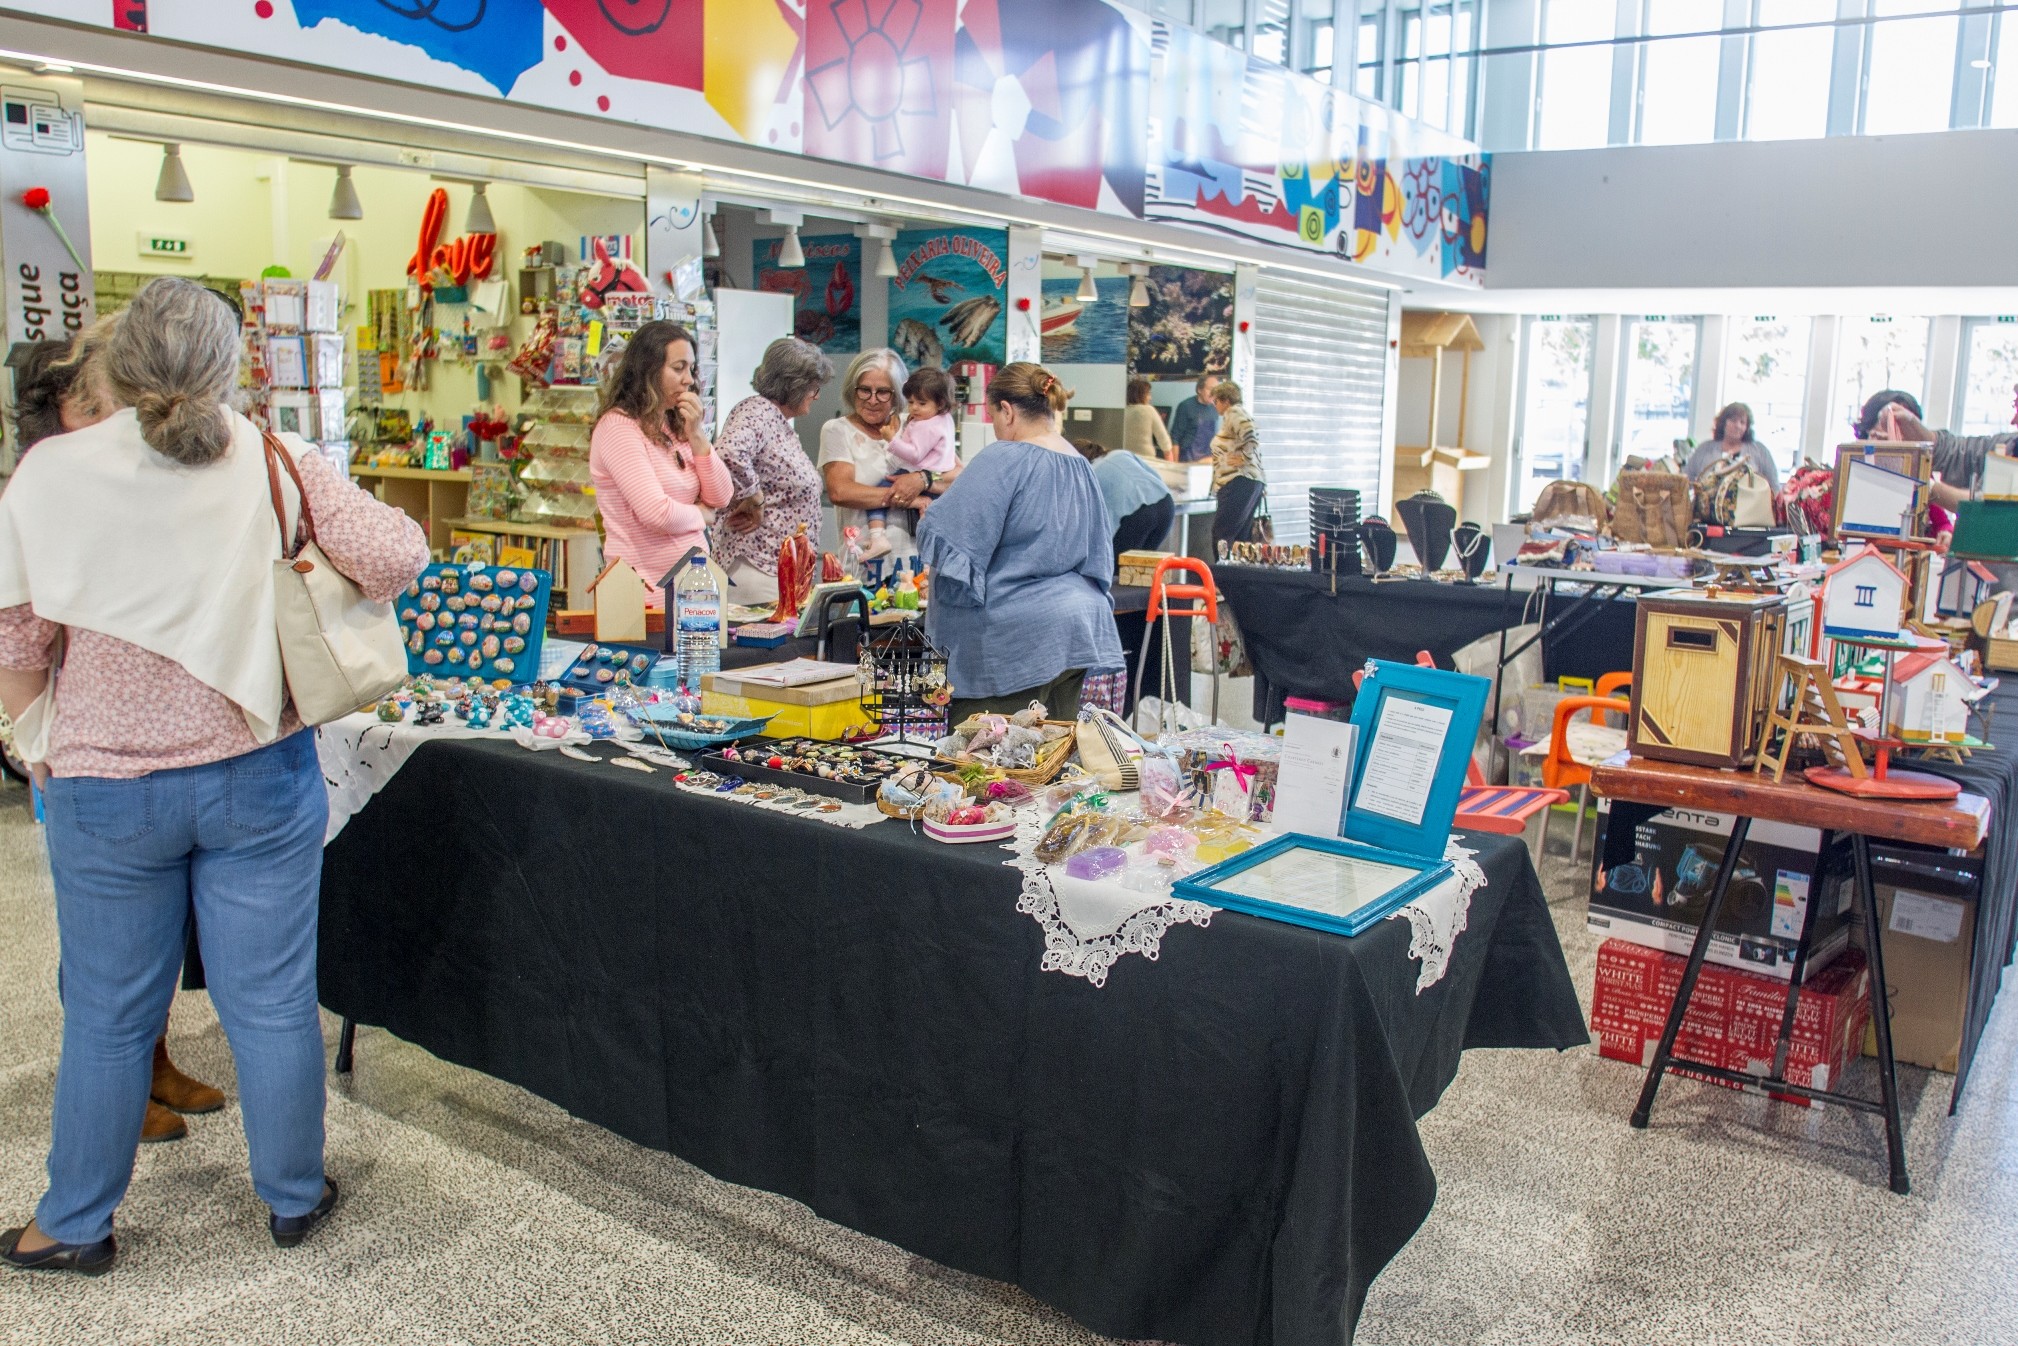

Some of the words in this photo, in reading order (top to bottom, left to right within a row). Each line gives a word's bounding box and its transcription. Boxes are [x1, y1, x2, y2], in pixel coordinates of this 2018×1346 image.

[407, 187, 497, 293] love
[894, 235, 950, 292] PEIXARIA
[951, 234, 1007, 289] OLIVEIRA
[18, 262, 51, 341] sque
[59, 271, 88, 332] aça
[684, 607, 717, 616] Penacova
[1661, 808, 1720, 827] enta
[1635, 833, 1651, 842] FACH
[1651, 919, 1680, 931] COMPACT
[1712, 932, 1736, 944] CLONIC
[1597, 975, 1643, 991] CHRISTMAS
[1598, 966, 1644, 984] WHITE
[1664, 1065, 1746, 1090] W.JUGAIS.C
